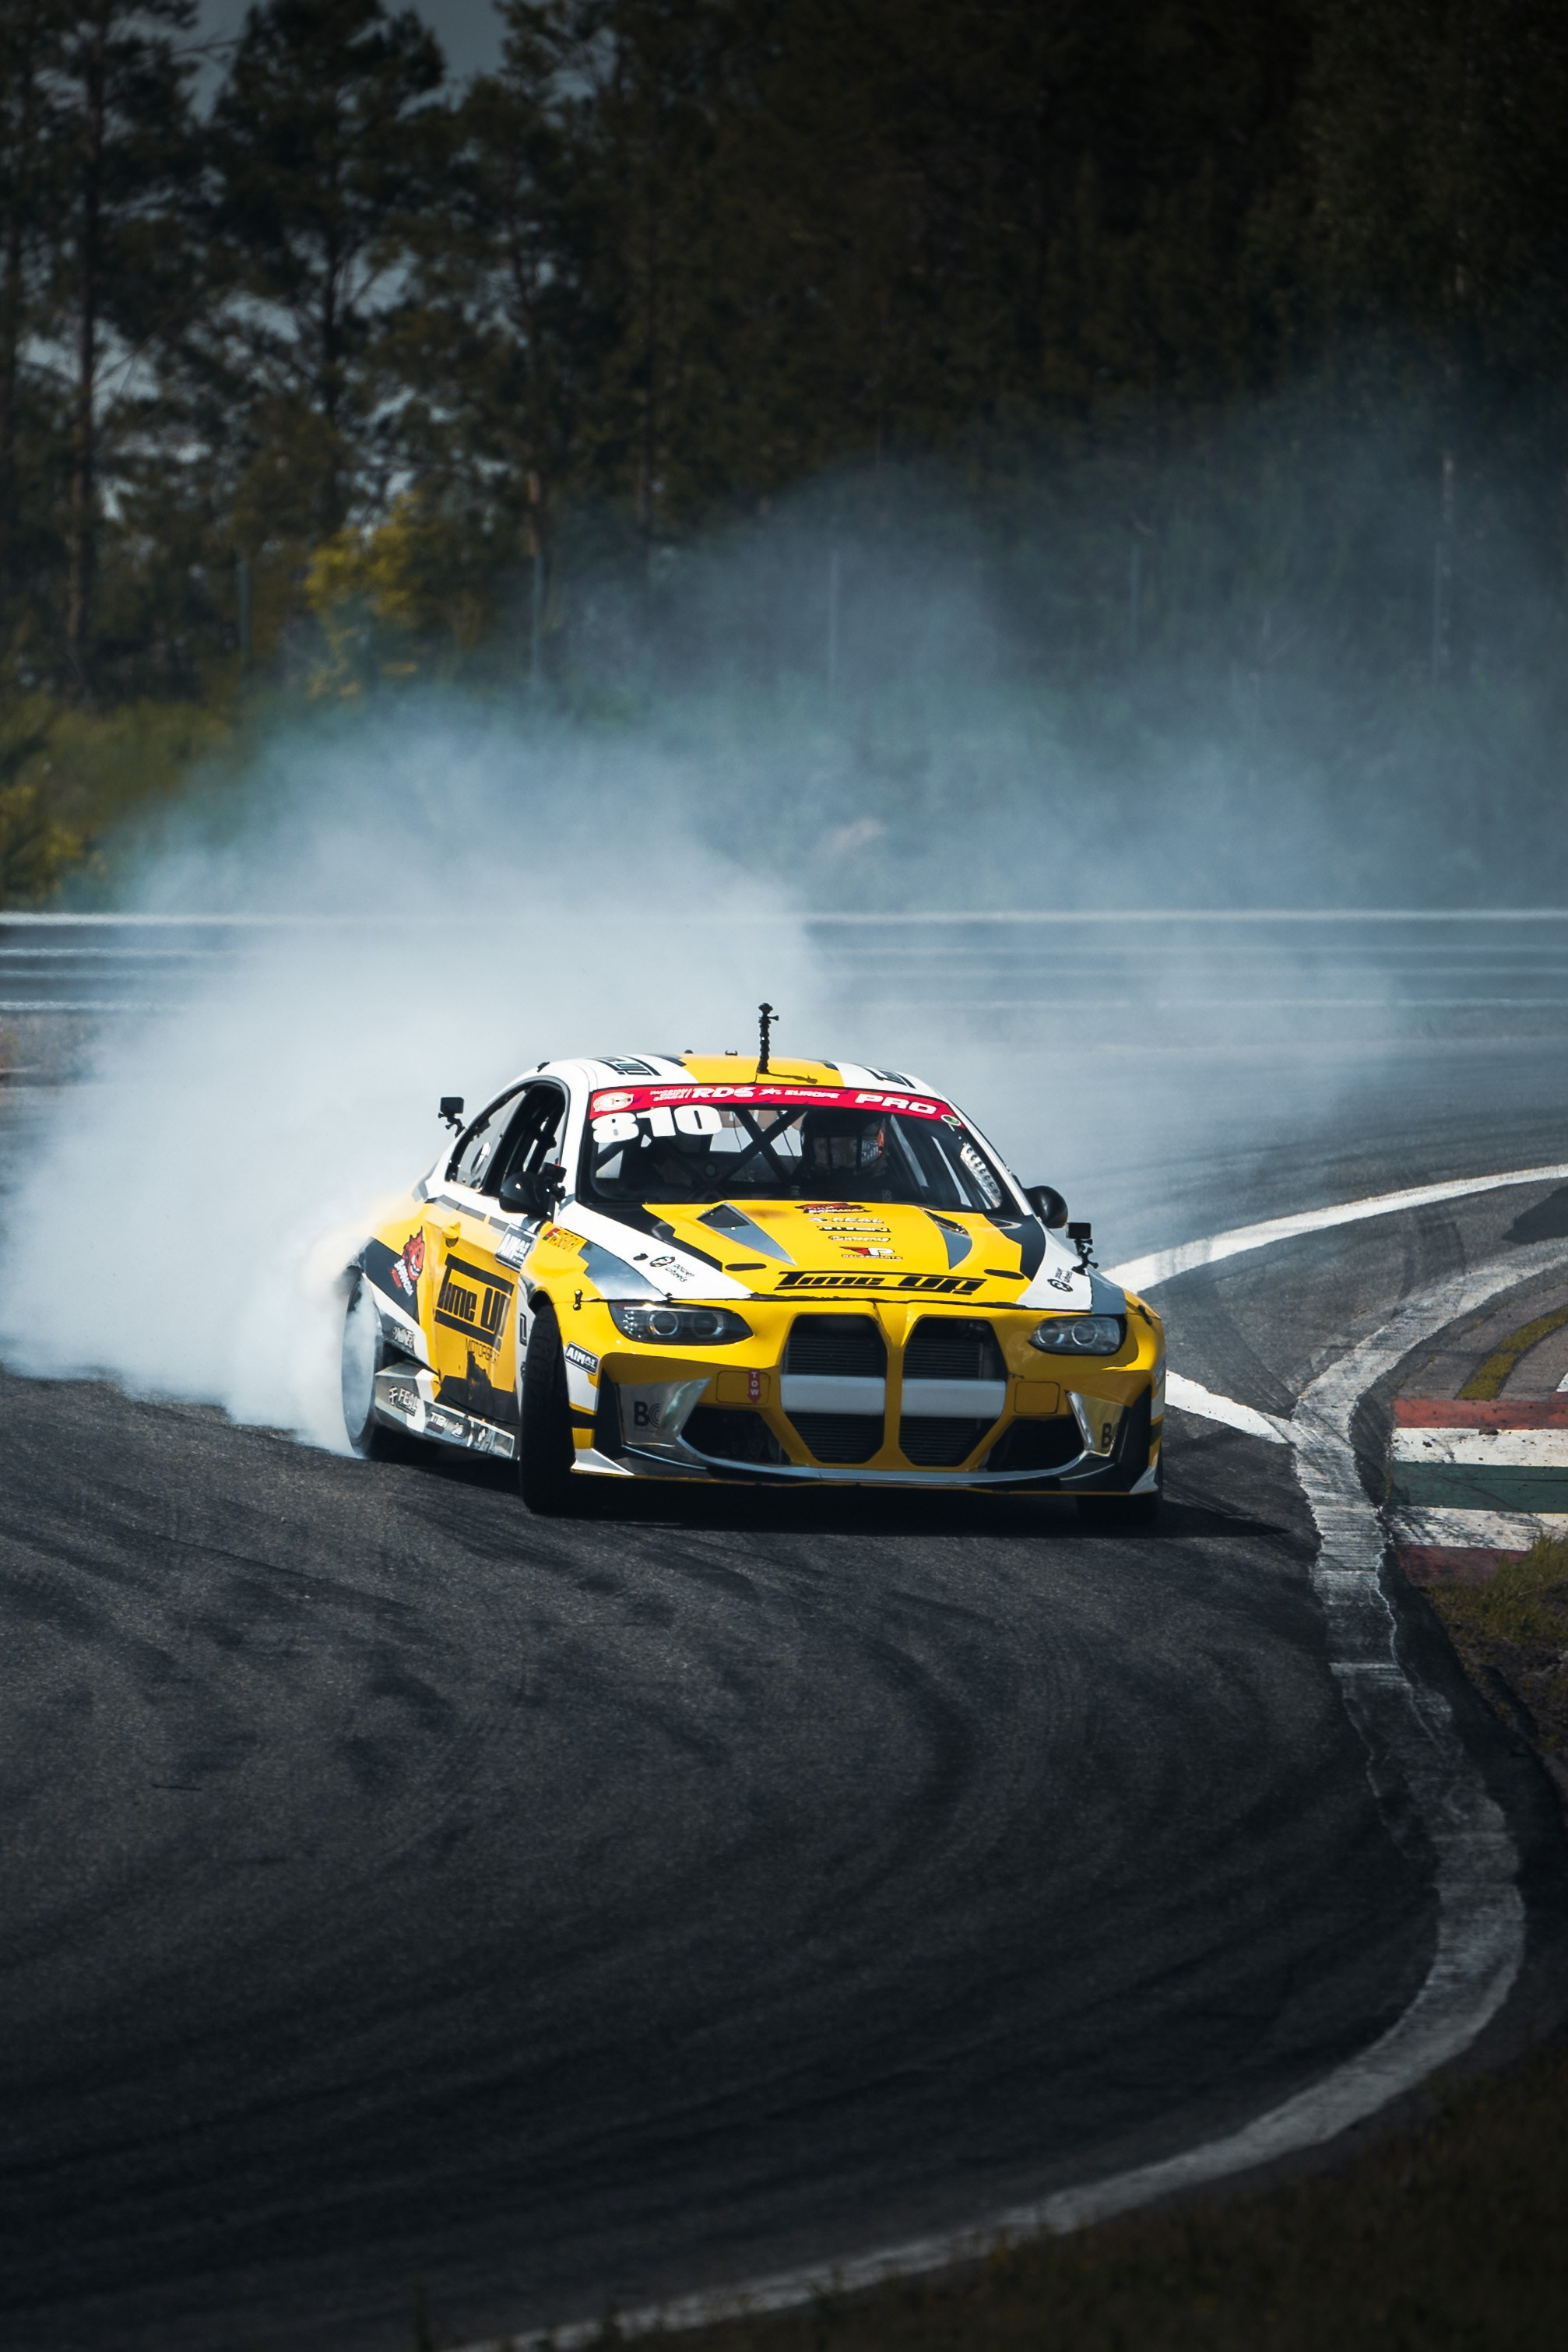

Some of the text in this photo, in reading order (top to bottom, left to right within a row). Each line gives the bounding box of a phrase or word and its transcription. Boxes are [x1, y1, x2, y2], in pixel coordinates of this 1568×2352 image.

[691, 1087, 756, 1099] RDS
[784, 1089, 841, 1099] EUROPE
[855, 1093, 937, 1115] PRO
[592, 1104, 722, 1144] 810
[774, 1271, 885, 1292] Time
[750, 1371, 760, 1396] TOW
